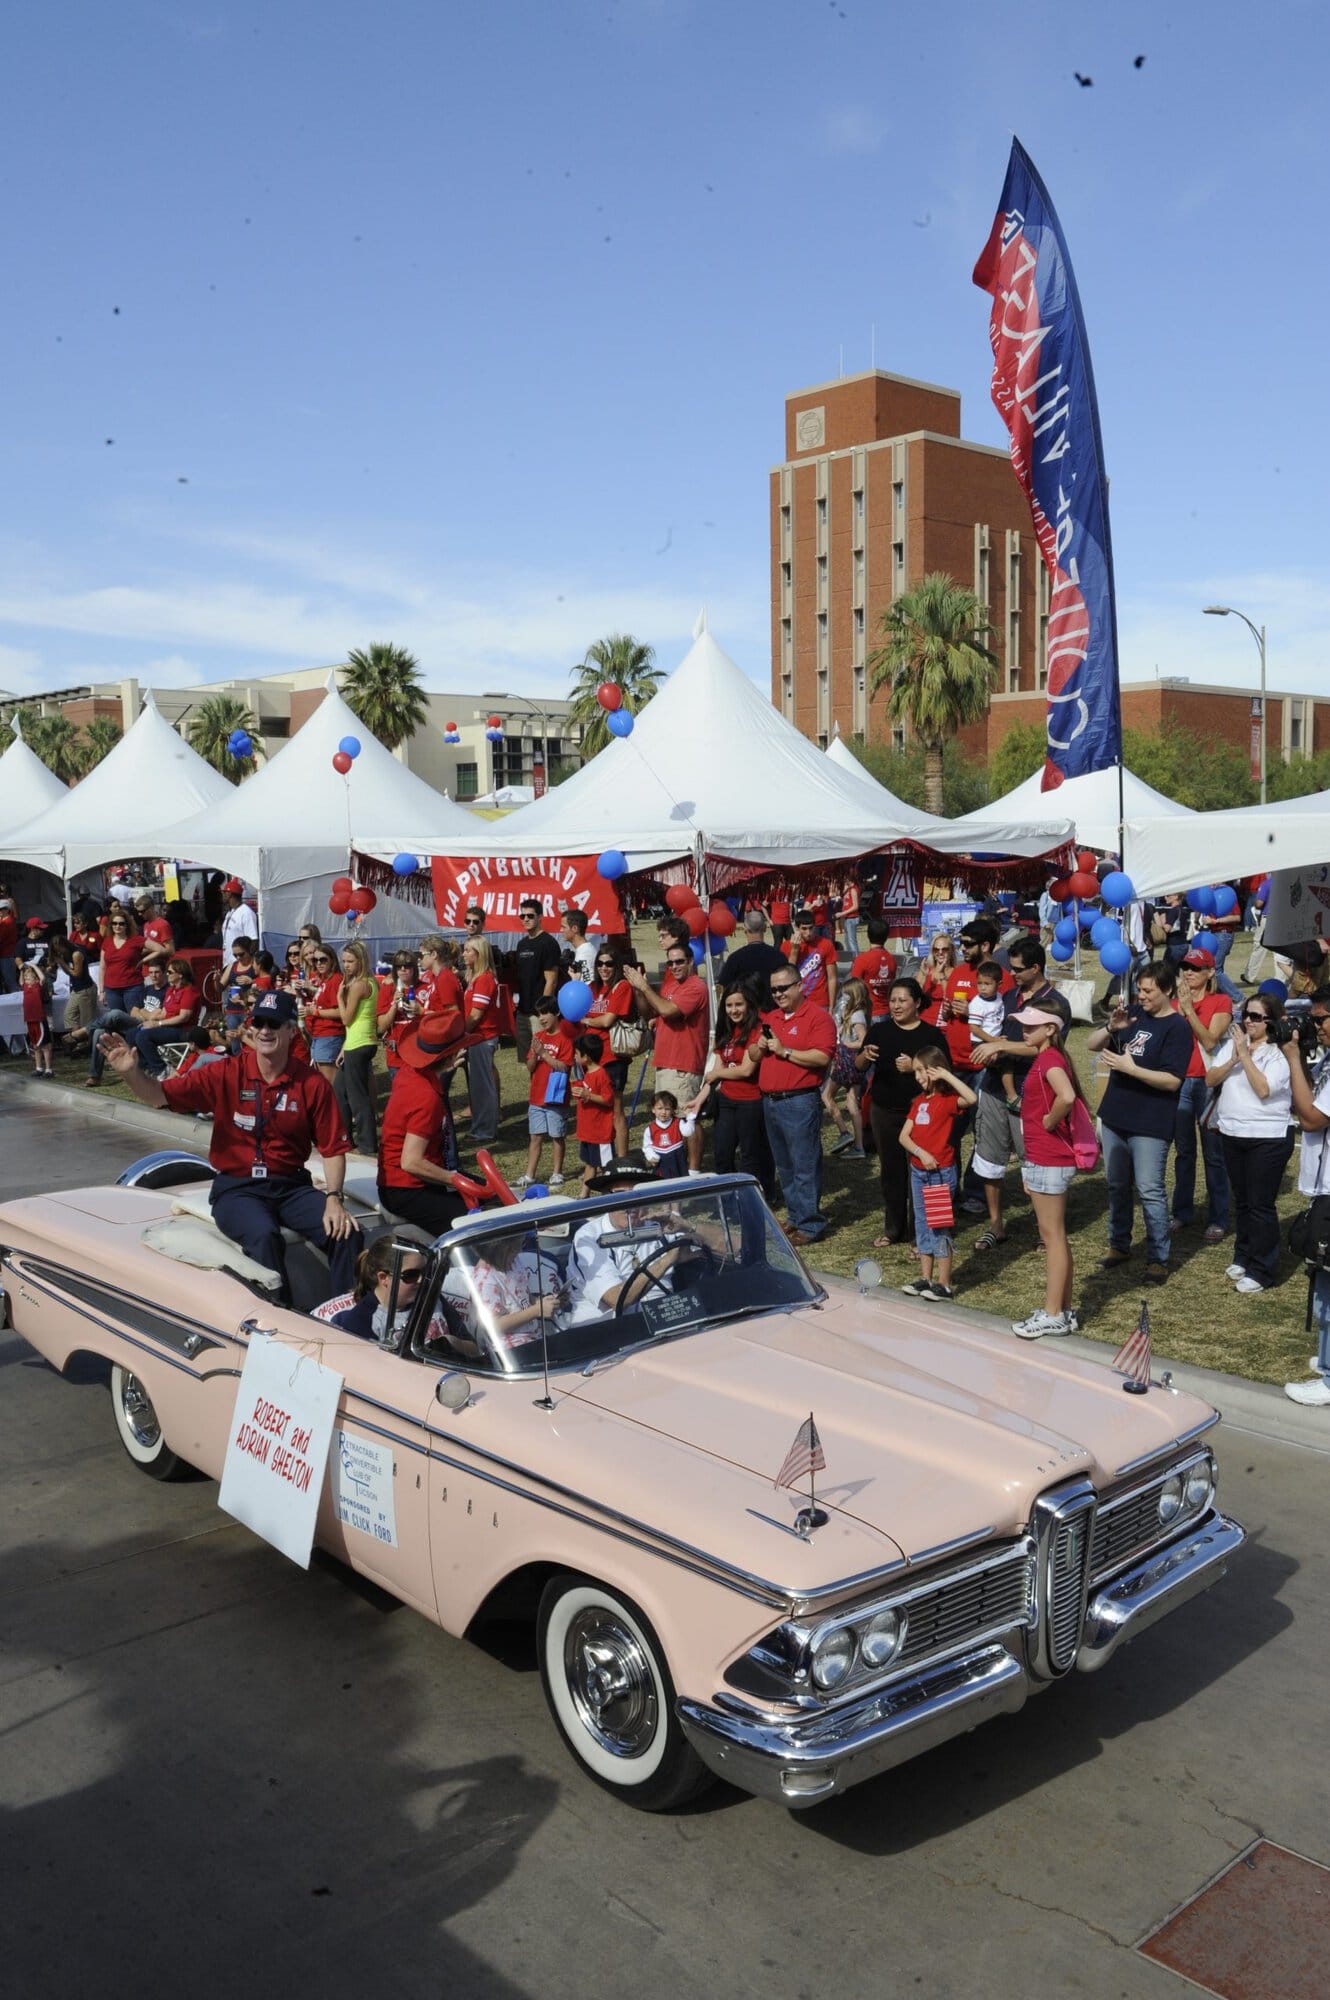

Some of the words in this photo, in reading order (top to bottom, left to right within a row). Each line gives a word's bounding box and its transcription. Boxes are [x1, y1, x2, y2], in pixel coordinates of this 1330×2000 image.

[443, 857, 492, 926] HAPPY
[883, 855, 920, 909] A
[259, 993, 278, 1010] A
[252, 1396, 292, 1440] ROBERT
[291, 1426, 313, 1457] and
[236, 1423, 272, 1465] ADRIAN
[271, 1445, 314, 1494] SHELTON
[339, 1495, 370, 1514] SPONSORED
[352, 1512, 371, 1533] CLICK
[374, 1523, 392, 1543] FORD
